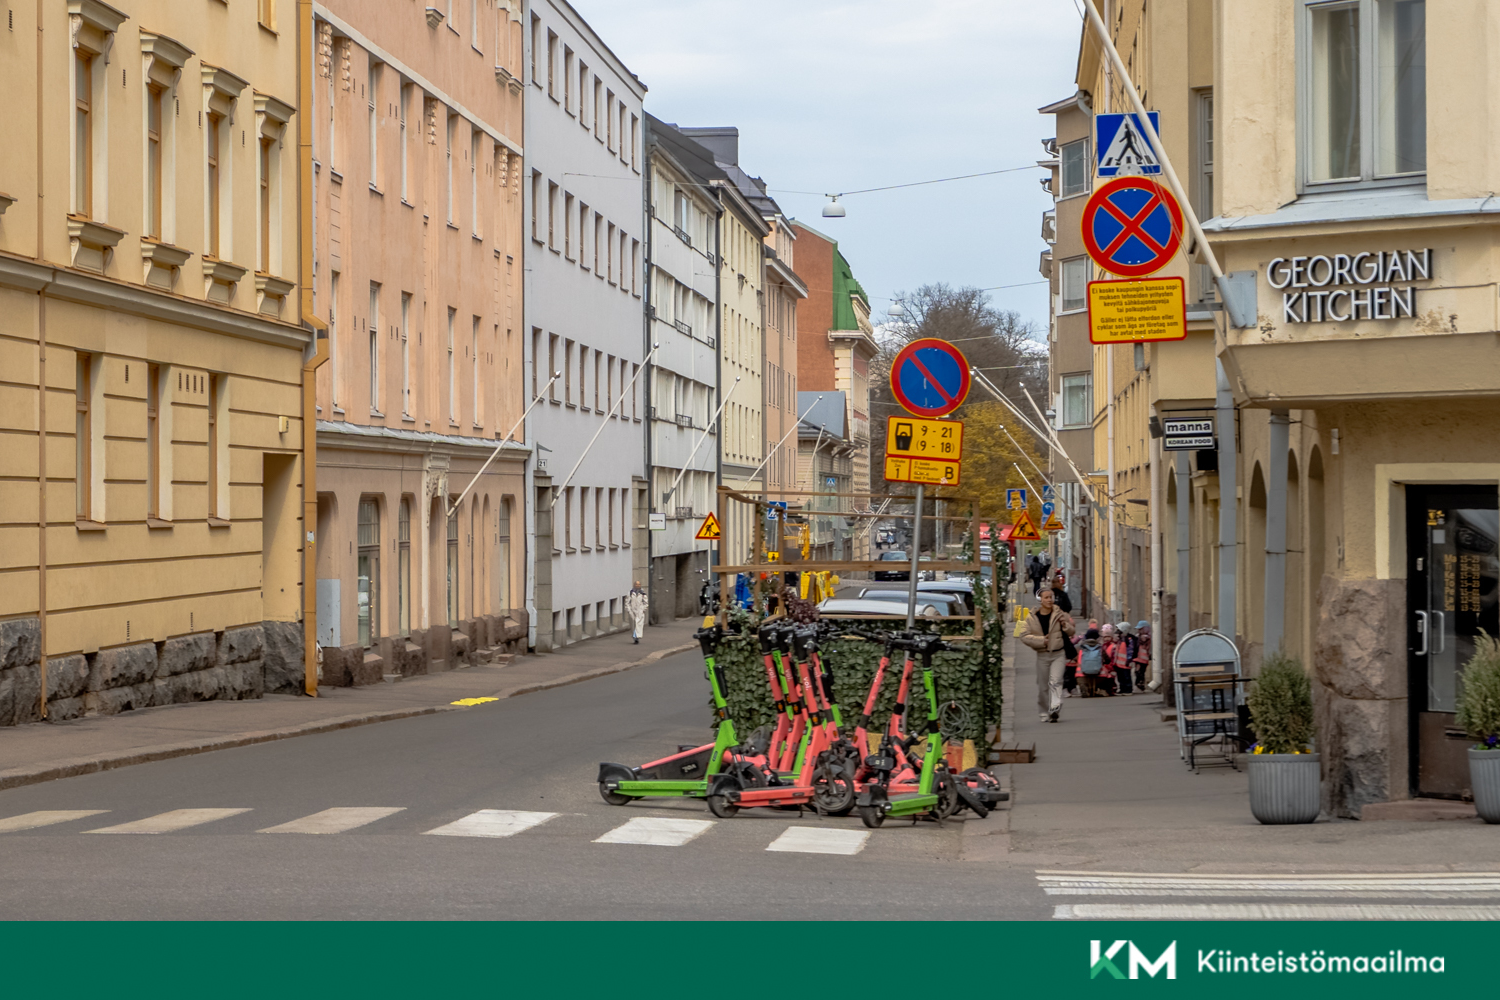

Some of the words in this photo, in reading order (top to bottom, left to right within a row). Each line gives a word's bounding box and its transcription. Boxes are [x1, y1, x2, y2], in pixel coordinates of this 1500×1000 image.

[1266, 247, 1430, 289] GEORGIAN
[1283, 286, 1413, 323] KITCHEN
[921, 425, 928, 436] 9
[941, 427, 952, 438] 21
[1167, 423, 1210, 432] manna
[941, 442, 955, 453] 18)
[896, 468, 899, 478] 1
[945, 467, 954, 480] B
[1444, 554, 1457, 563] Ma
